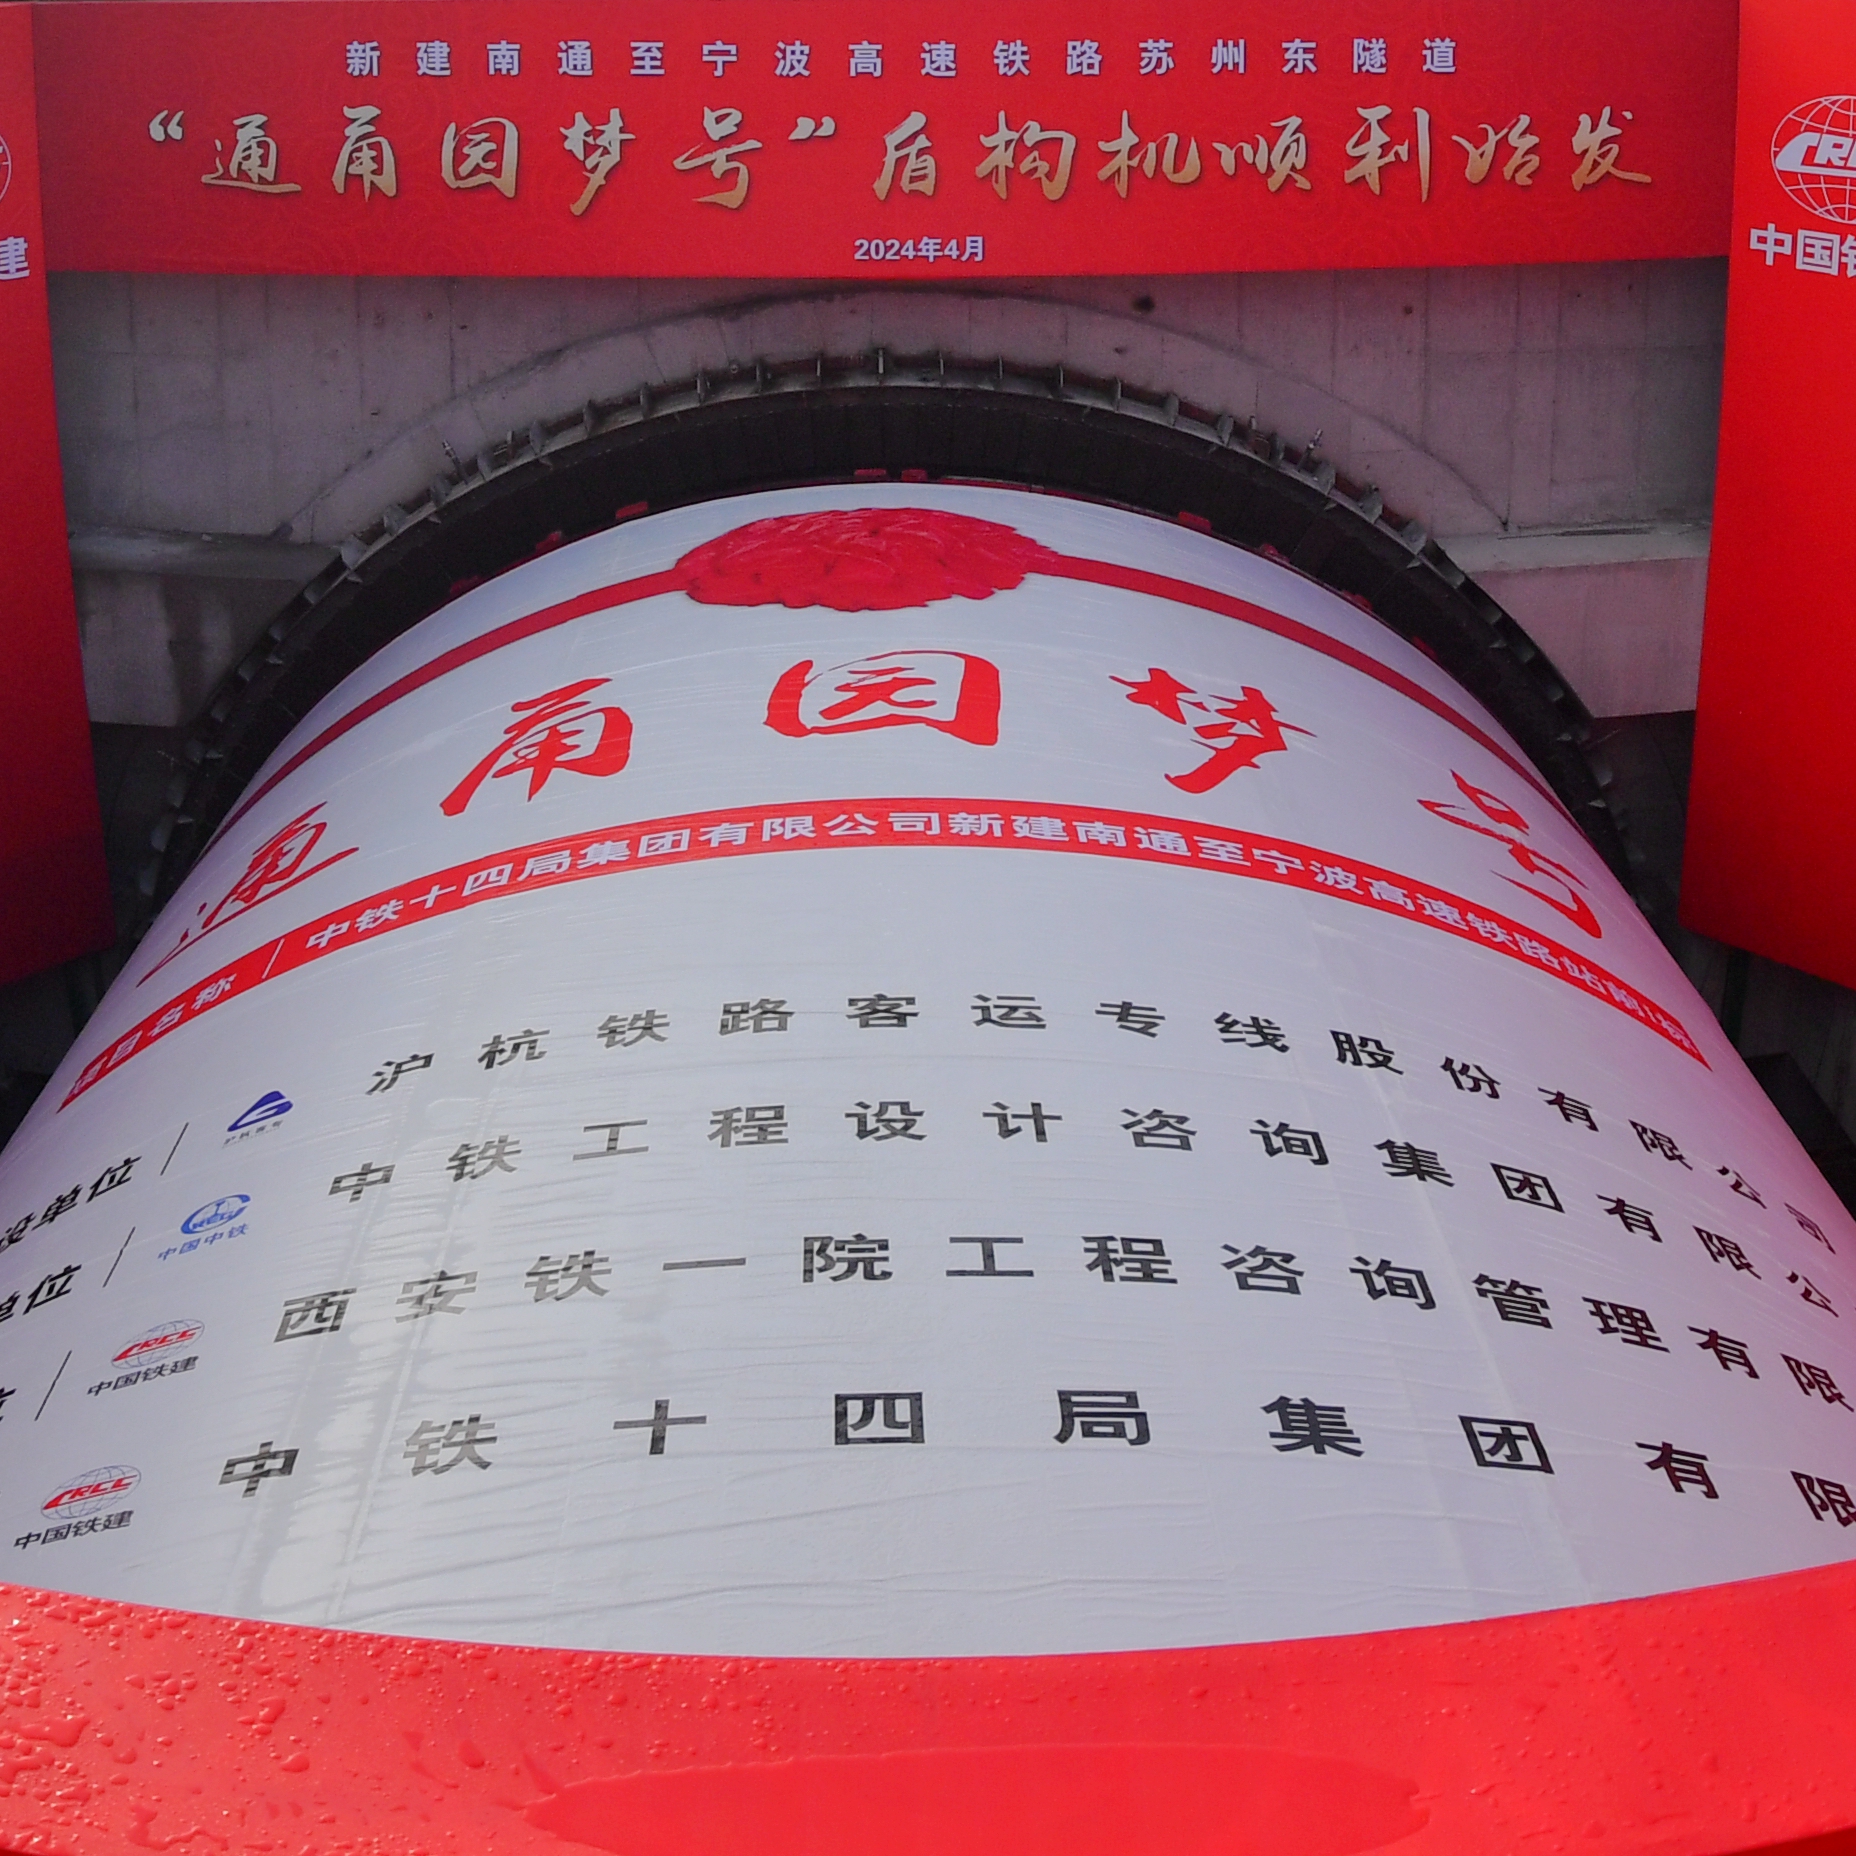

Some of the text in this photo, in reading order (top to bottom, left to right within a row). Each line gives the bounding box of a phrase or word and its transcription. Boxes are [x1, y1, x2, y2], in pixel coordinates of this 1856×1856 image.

[346, 36, 1457, 79] 新建南通至宁波高速铁路苏州东隧道
[854, 234, 986, 263] 2024年4月
[364, 992, 1837, 1255] 沪杭铁路客运专线股份有限公司
[86, 1354, 199, 1398] 中国铁建
[13, 1509, 135, 1551] 中国铁建
